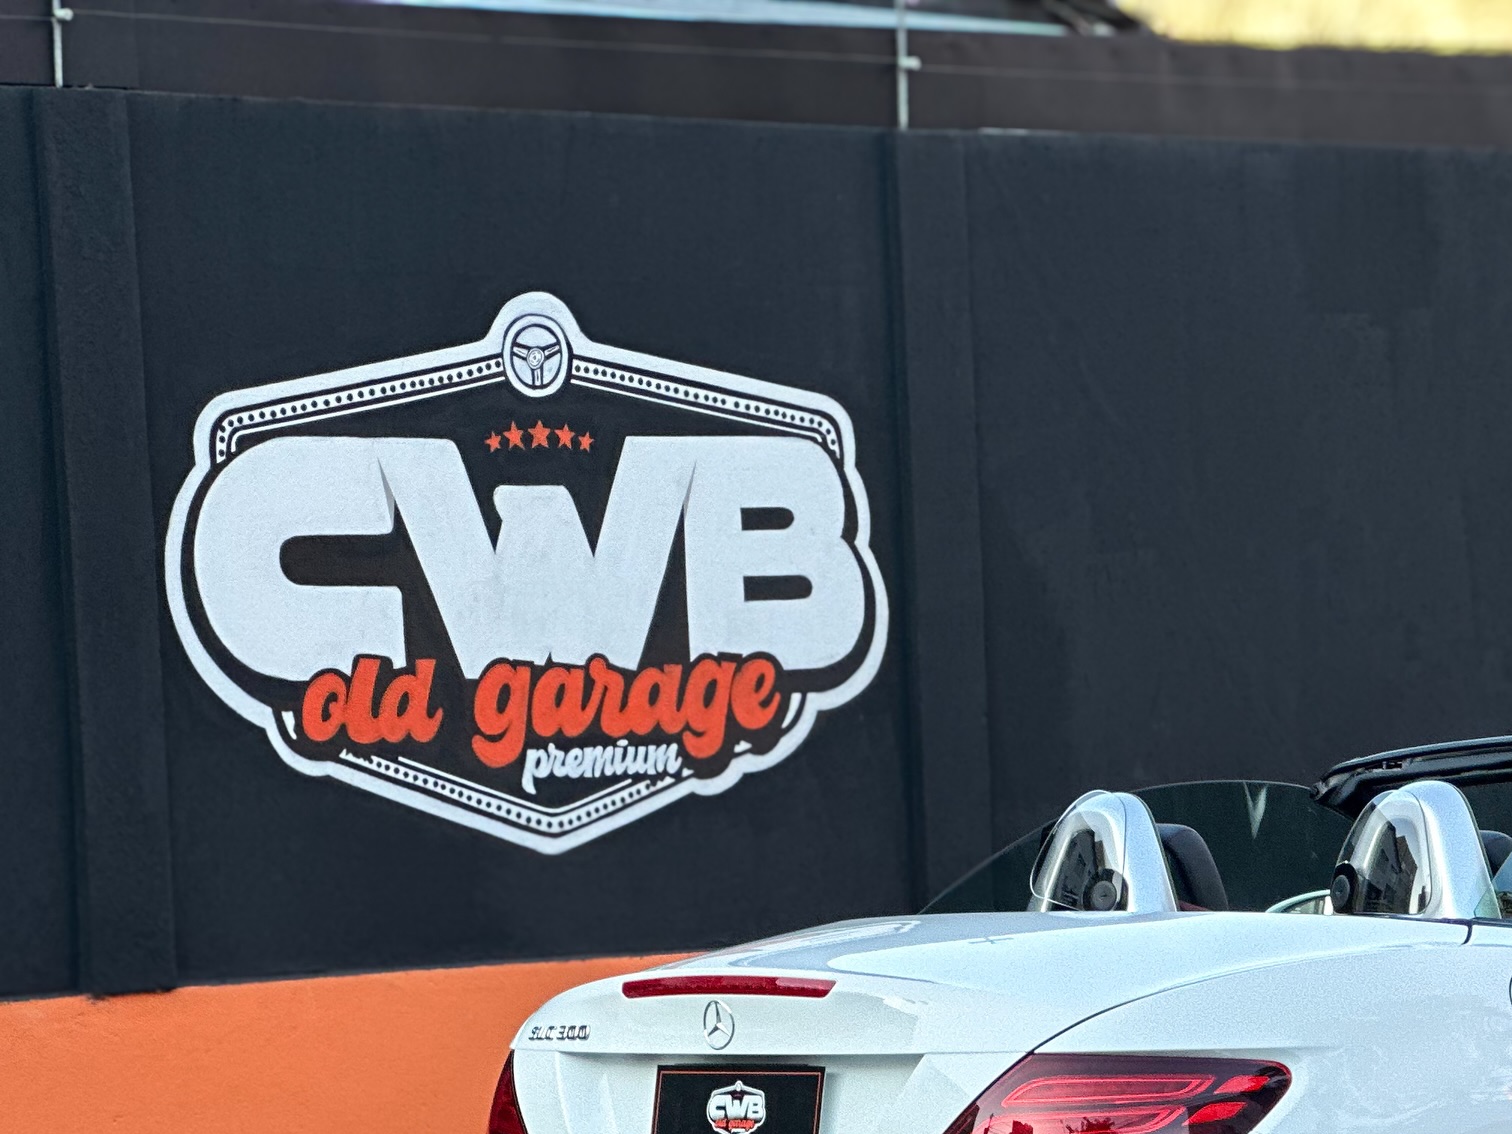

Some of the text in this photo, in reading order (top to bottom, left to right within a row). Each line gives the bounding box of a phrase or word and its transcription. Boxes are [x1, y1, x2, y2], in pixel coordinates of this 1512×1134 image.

[194, 435, 866, 682] CWB
[302, 653, 781, 768] old garage
[521, 739, 683, 795] premium
[556, 1025, 591, 1041] 300
[709, 1094, 764, 1120] CWB
